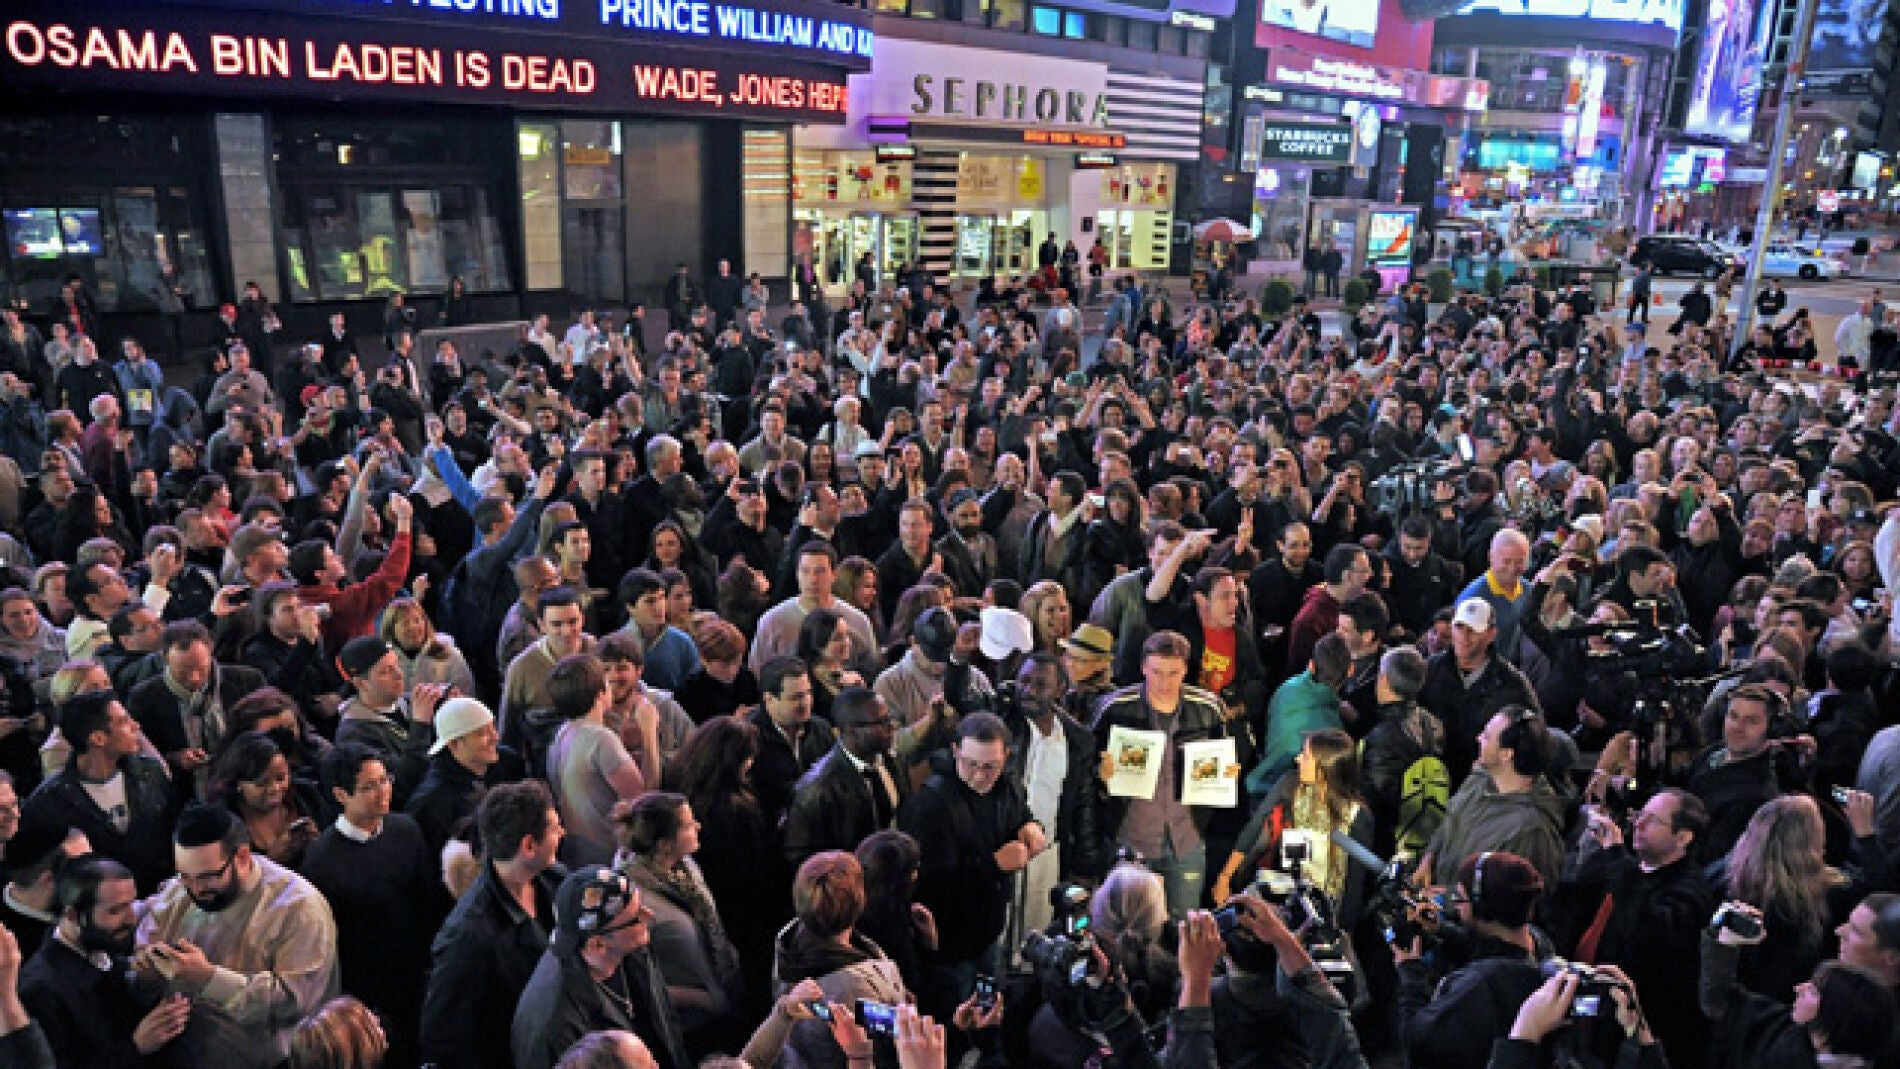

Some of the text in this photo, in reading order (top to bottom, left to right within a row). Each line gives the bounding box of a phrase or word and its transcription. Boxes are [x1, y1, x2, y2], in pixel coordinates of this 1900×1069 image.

[601, 0, 710, 34] PRINCE
[715, 5, 814, 46] WILLIAM
[816, 20, 855, 54] AND
[5, 20, 198, 72] OSAMA
[210, 34, 290, 78] BIN
[305, 41, 443, 85] LADEN
[454, 49, 491, 87] IS
[501, 55, 595, 93] DEAD
[634, 64, 724, 108] WADE,
[729, 73, 805, 108] JONES
[911, 73, 1110, 128] SEPHORA
